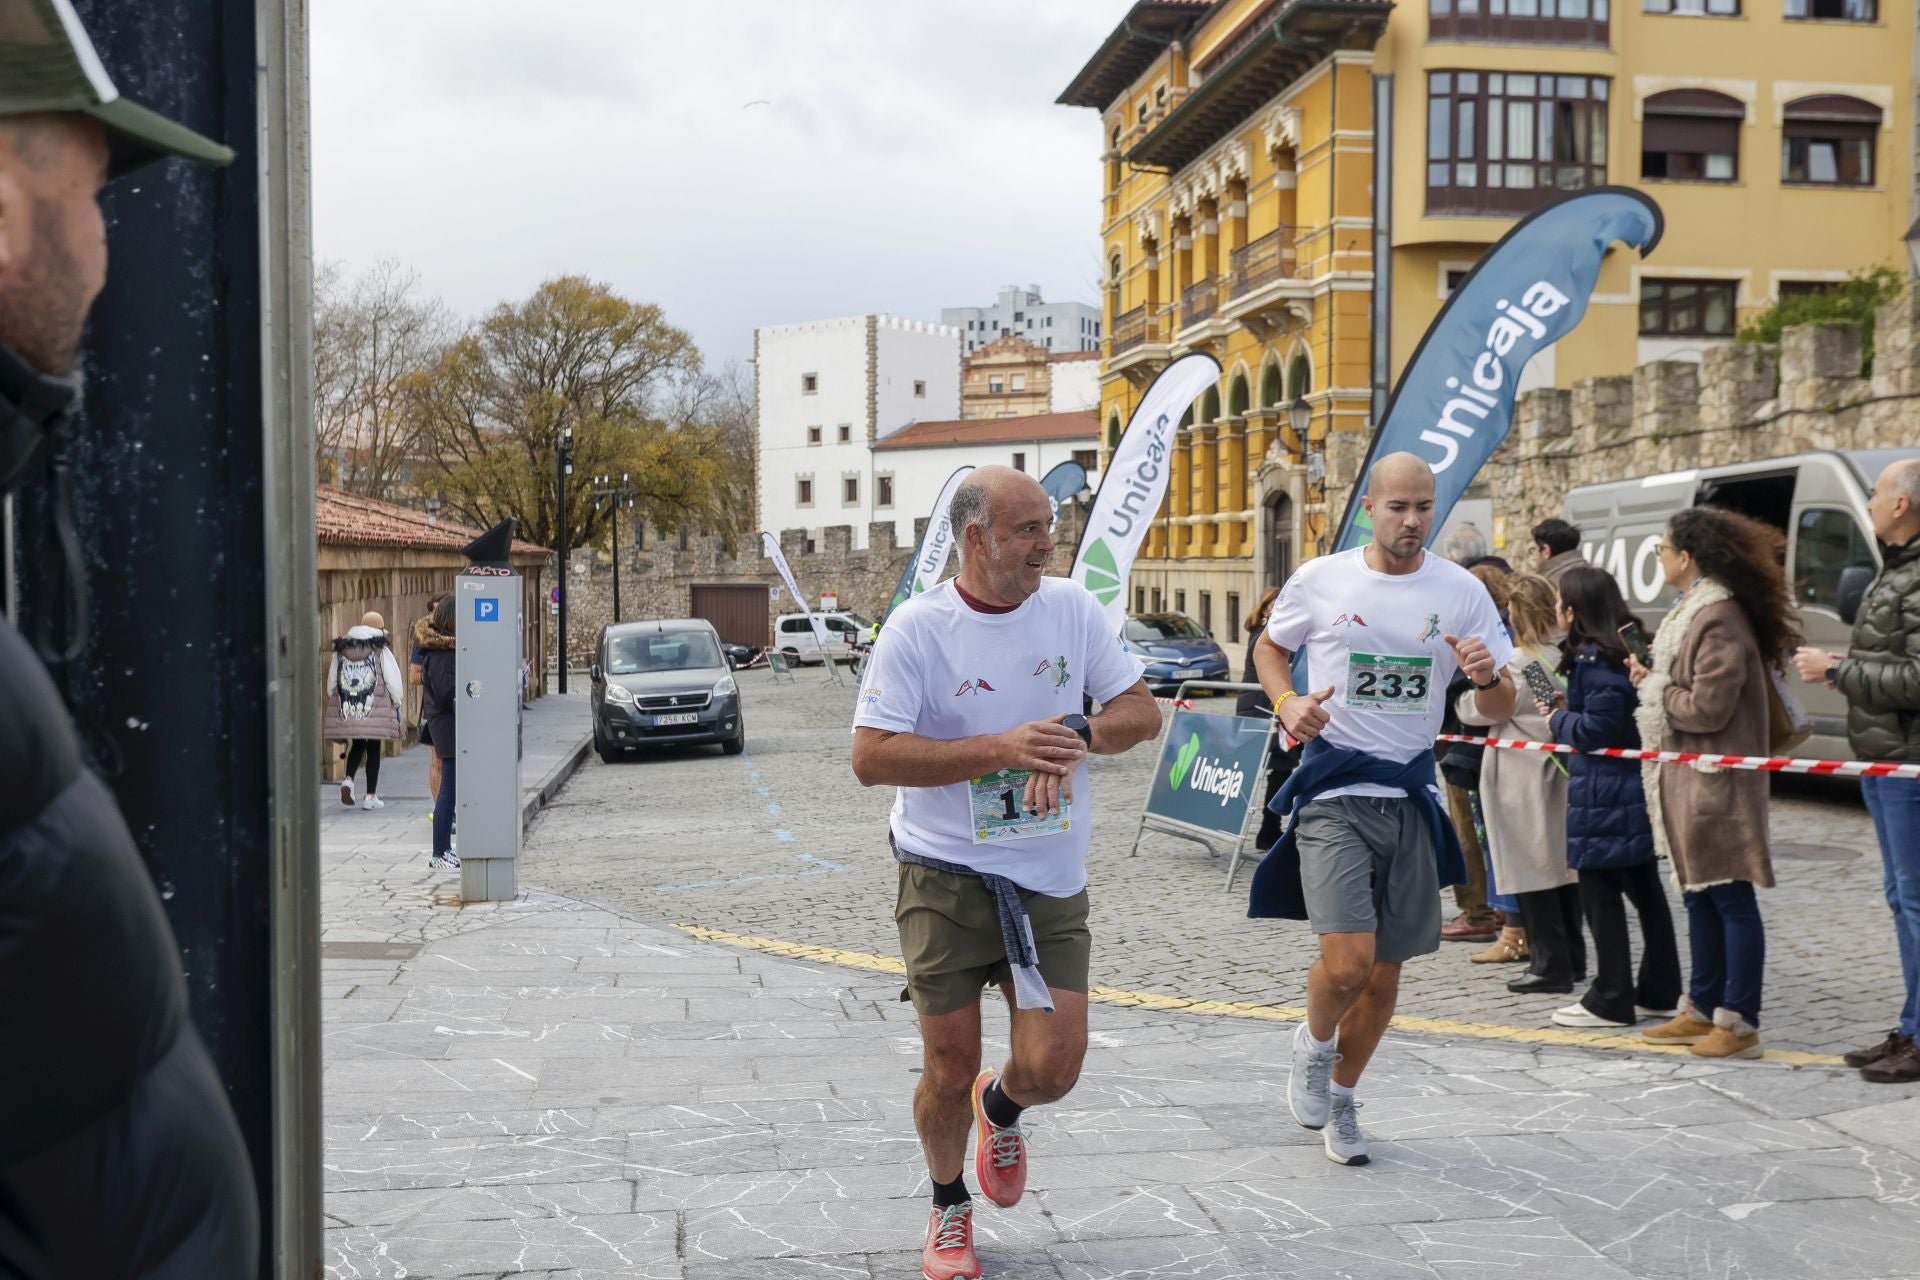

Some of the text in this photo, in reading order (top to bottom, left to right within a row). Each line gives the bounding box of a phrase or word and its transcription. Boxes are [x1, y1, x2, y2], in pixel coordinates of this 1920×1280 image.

[1419, 280, 1571, 475] Unicaja
[480, 602, 494, 618] P
[1355, 671, 1427, 698] 233
[1190, 756, 1244, 806] Unicaja
